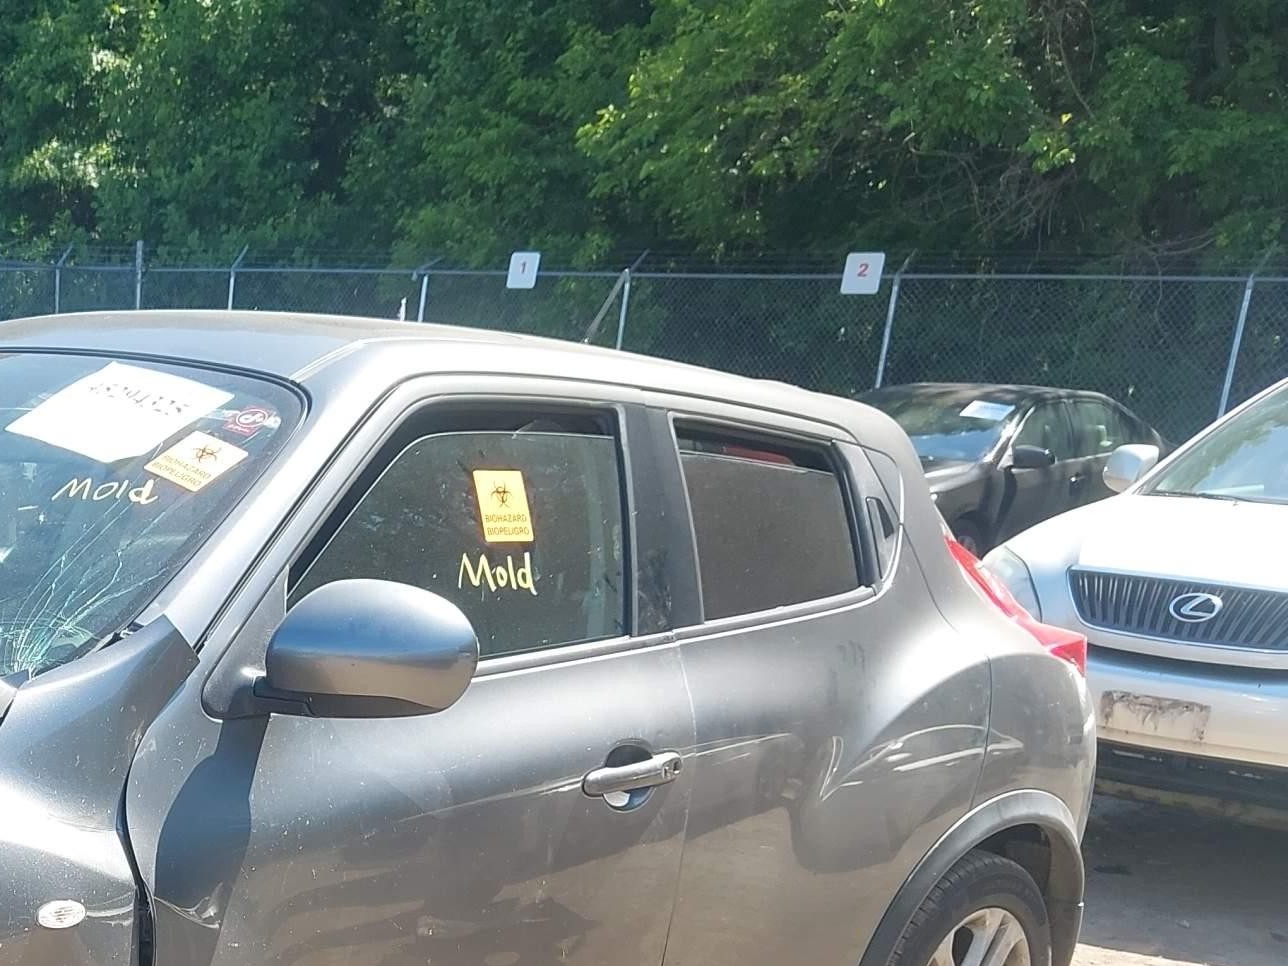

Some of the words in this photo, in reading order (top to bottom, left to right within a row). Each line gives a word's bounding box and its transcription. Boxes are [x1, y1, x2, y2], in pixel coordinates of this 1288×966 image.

[857, 263, 869, 278] 2
[485, 513, 527, 523] BIOHAZARD
[487, 526, 530, 536] BIOPELIGRO
[458, 551, 538, 596] Mold
